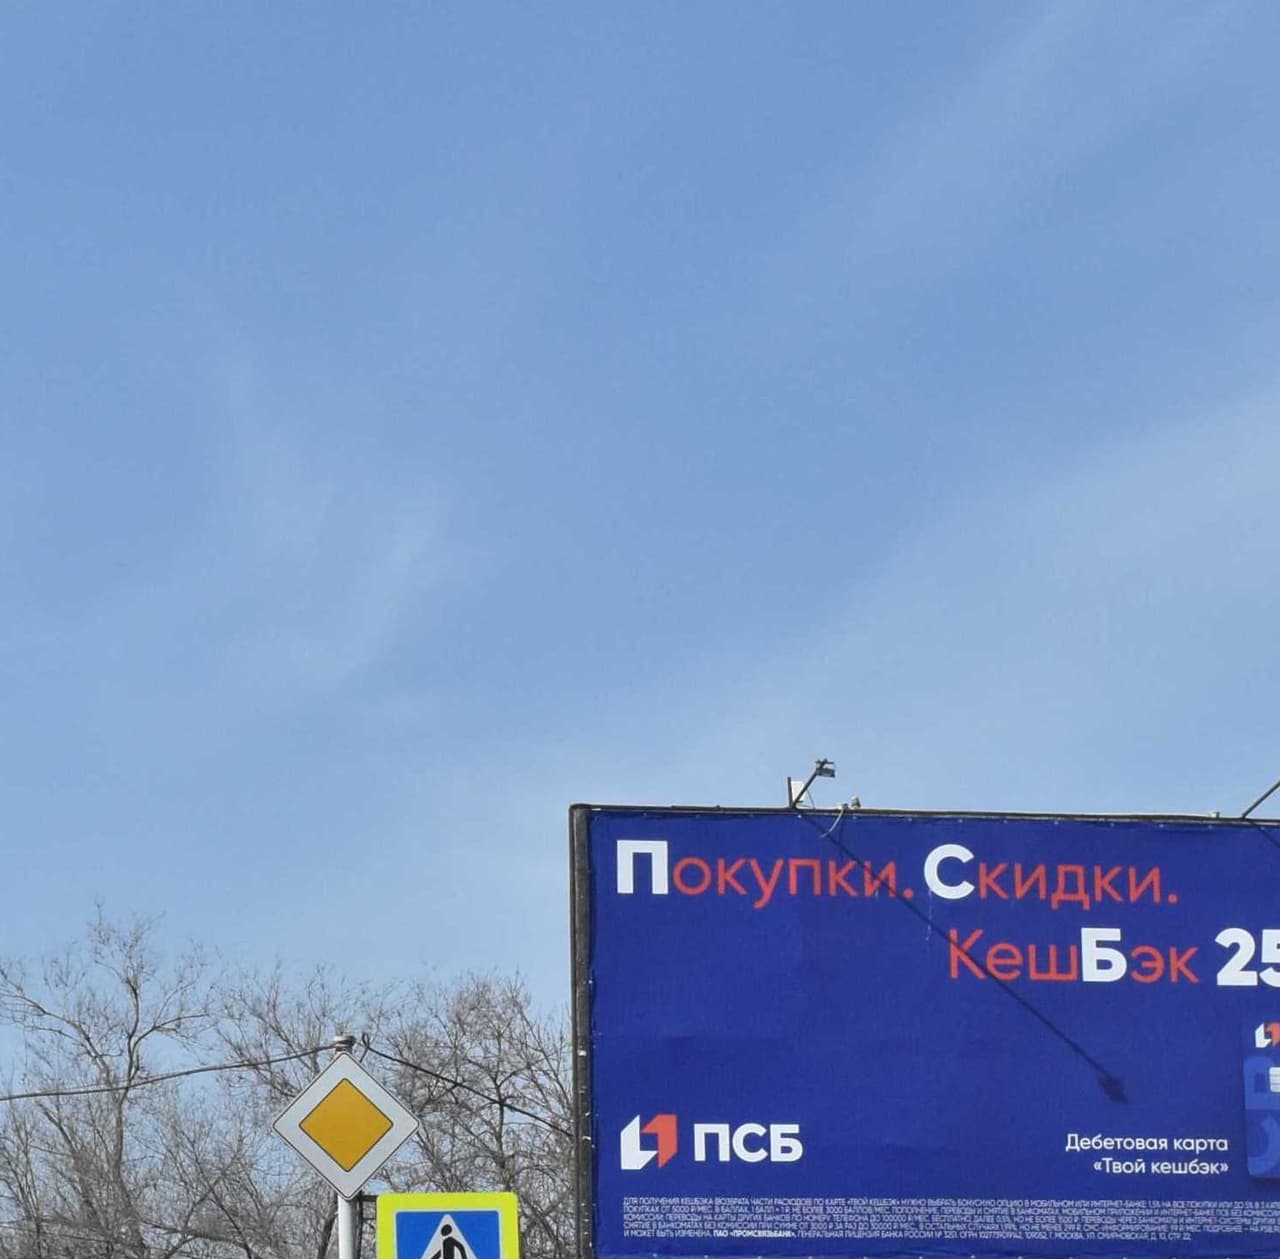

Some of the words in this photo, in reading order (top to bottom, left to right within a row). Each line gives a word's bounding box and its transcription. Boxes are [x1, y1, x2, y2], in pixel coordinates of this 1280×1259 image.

[617, 840, 914, 909] Покупки.
[924, 844, 1178, 910] Скидки.
[948, 927, 1199, 983] КешБэк
[694, 1123, 803, 1163] ПСБ
[1065, 1133, 1168, 1152] Дебетовая
[1173, 1137, 1229, 1154] карта
[1093, 1157, 1146, 1174] «Твой
[1151, 1158, 1229, 1175] кешбэк»
